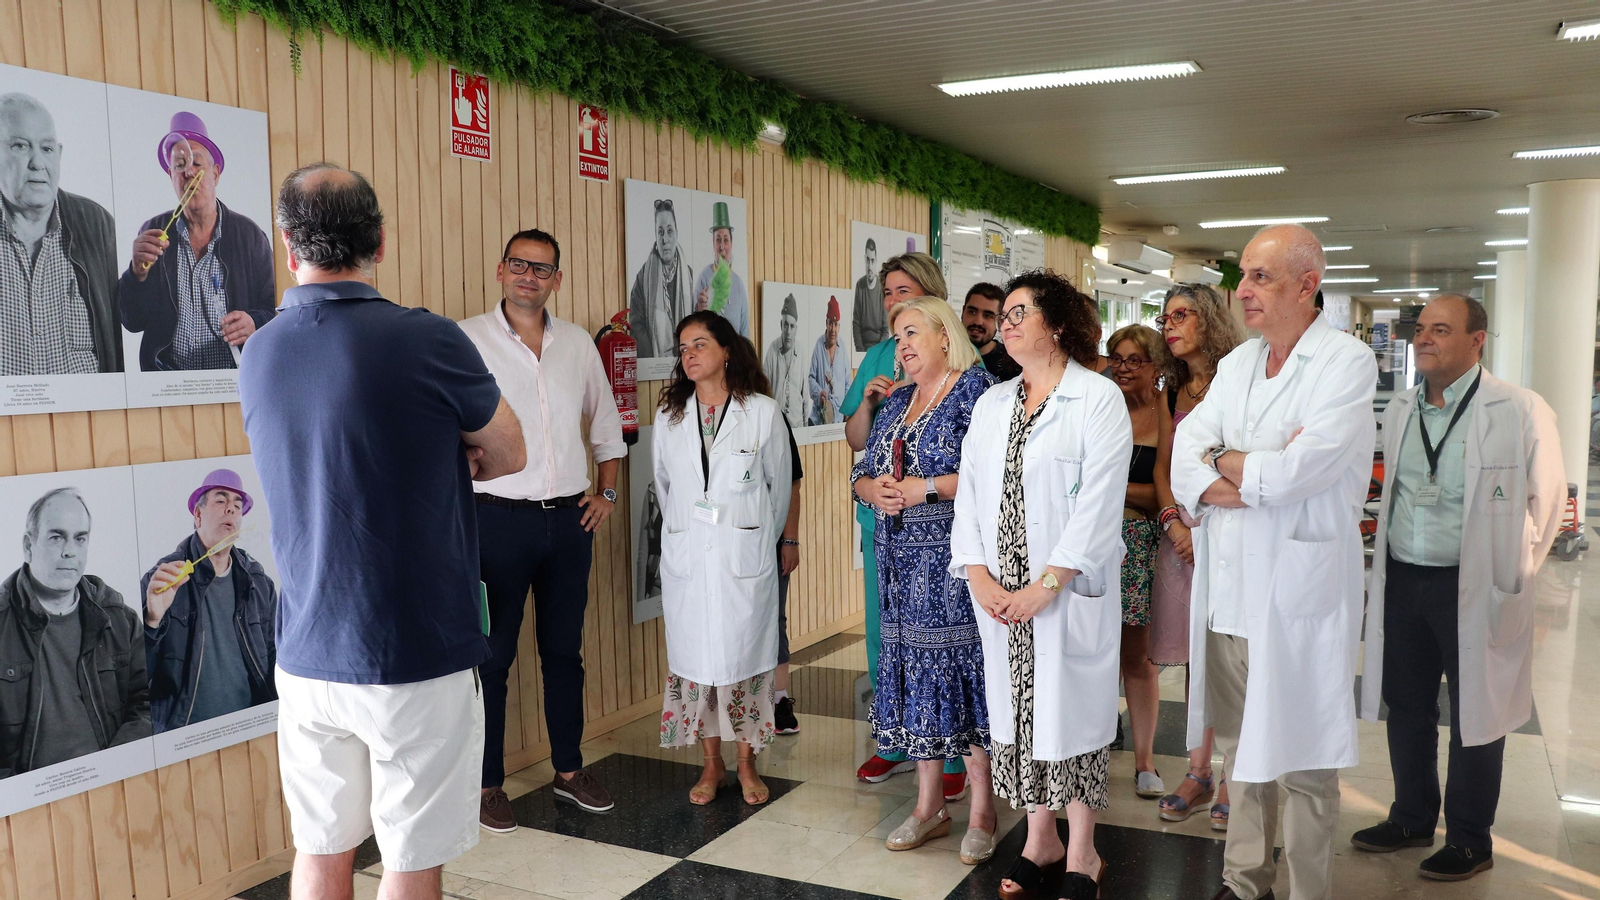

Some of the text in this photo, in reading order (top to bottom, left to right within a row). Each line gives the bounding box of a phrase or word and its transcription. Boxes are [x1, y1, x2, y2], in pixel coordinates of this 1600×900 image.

[454, 132, 488, 147] PULSADOR
[454, 142, 488, 157] DE ALARMA
[580, 161, 608, 175] EXTINTOR
[622, 412, 636, 421] ads
